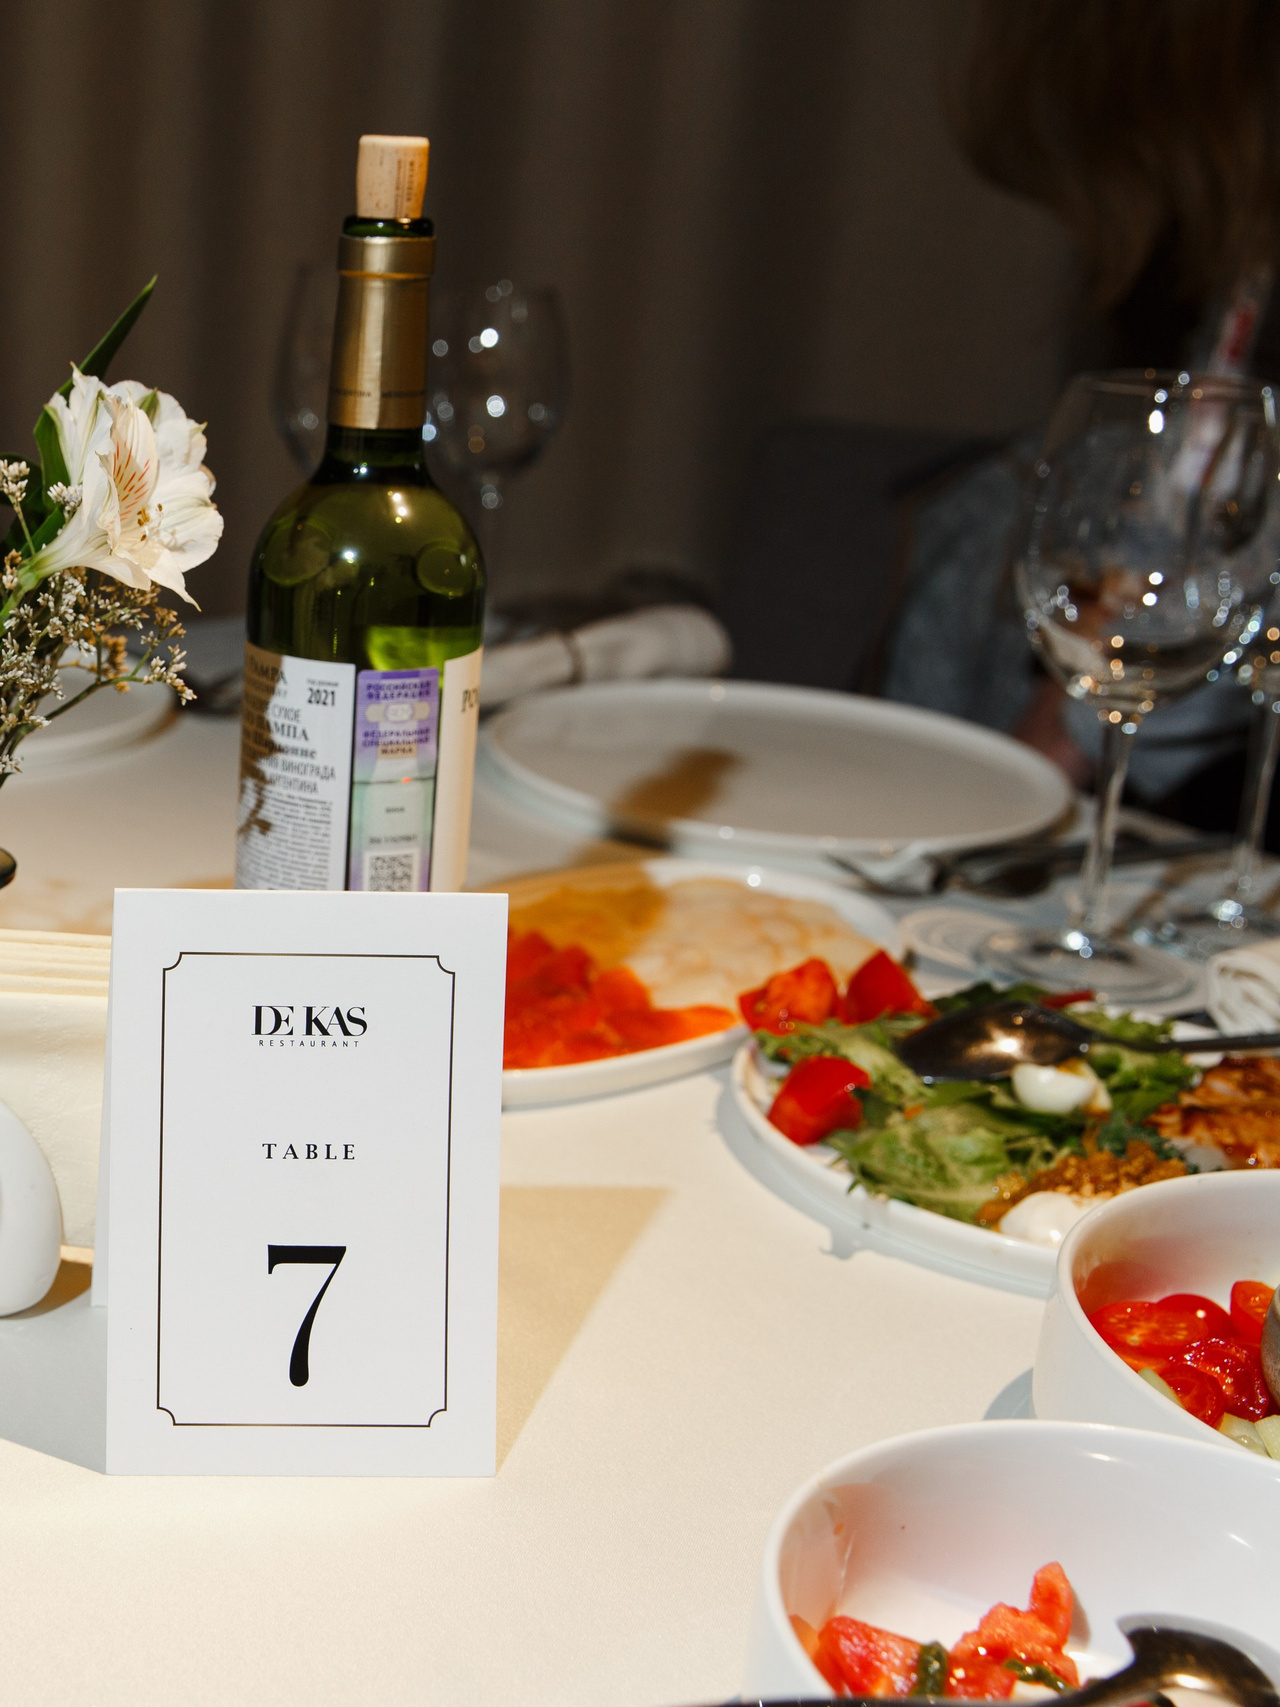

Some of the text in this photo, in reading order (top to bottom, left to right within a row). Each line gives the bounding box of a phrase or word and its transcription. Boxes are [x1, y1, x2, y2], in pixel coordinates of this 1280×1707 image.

[307, 688, 336, 707] 2021
[251, 1005, 368, 1037] DE KAS
[258, 1040, 360, 1048] RESTAURANT
[262, 1143, 357, 1161] TABLE
[267, 1244, 347, 1387] 7
